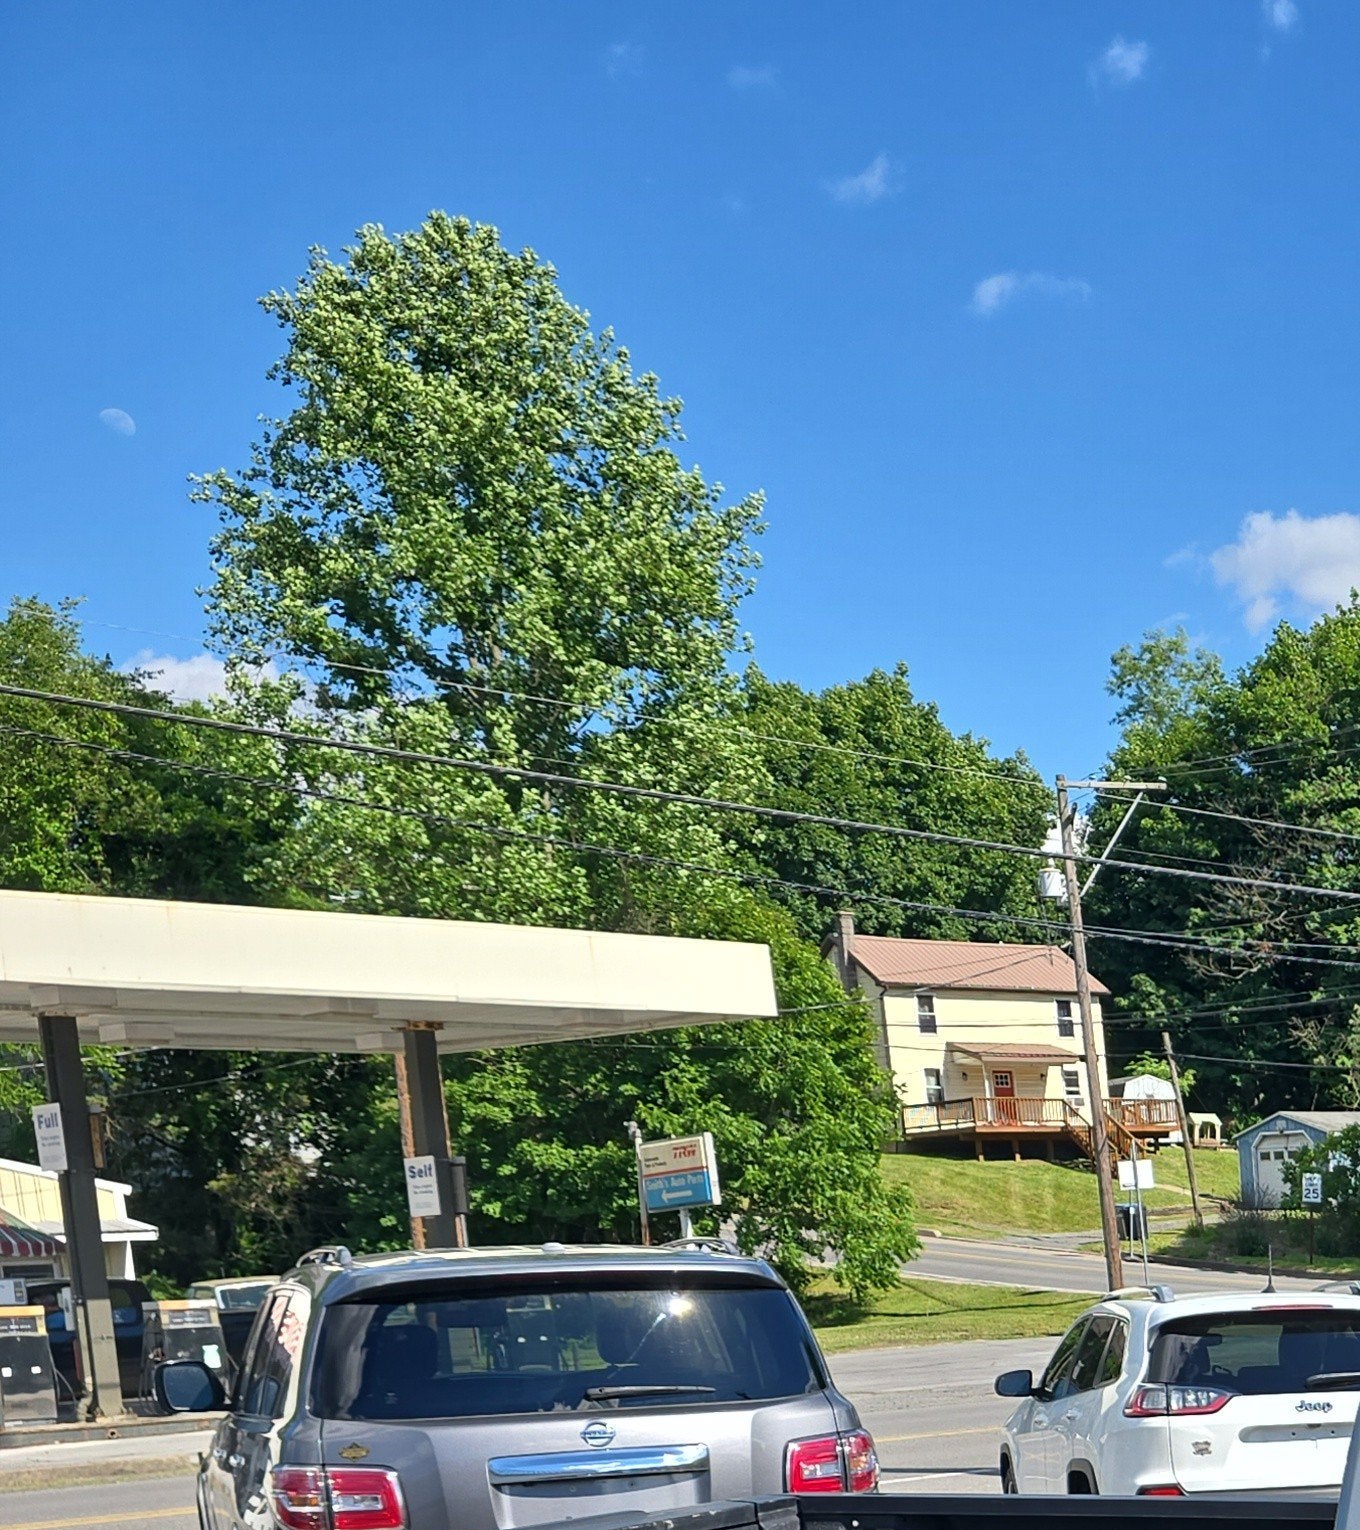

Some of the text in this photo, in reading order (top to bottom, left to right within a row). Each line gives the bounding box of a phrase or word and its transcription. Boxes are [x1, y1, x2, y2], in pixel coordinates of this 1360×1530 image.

[37, 1112, 59, 1130] Full
[408, 1163, 433, 1179] Self
[1304, 1188, 1319, 1199] 25
[1295, 1400, 1334, 1413] Jeep
